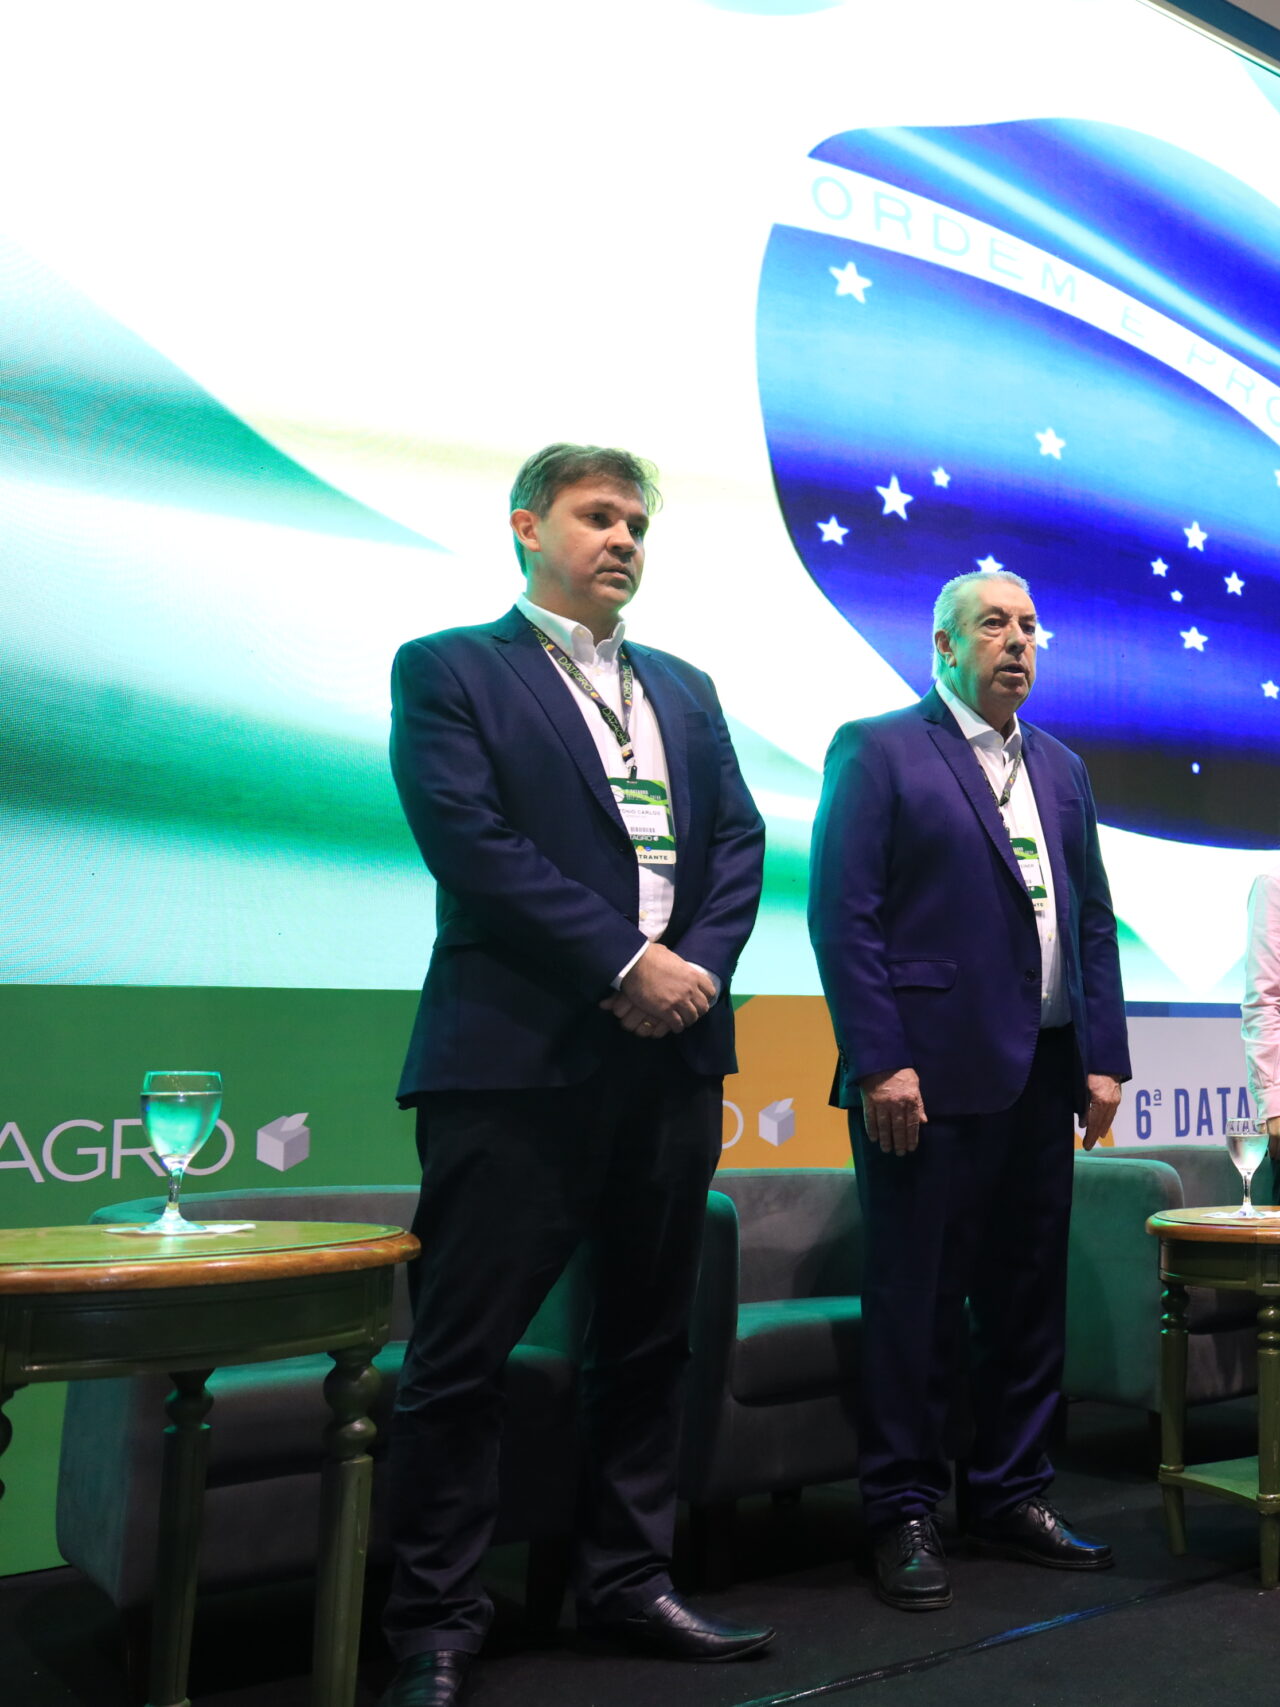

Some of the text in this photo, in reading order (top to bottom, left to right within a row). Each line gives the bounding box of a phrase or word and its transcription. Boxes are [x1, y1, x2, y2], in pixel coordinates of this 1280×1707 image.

[811, 176, 1078, 303] ORDEM
[1119, 305, 1146, 340] E
[558, 656, 593, 692] DATAGRO
[1174, 1086, 1252, 1137] DATA
